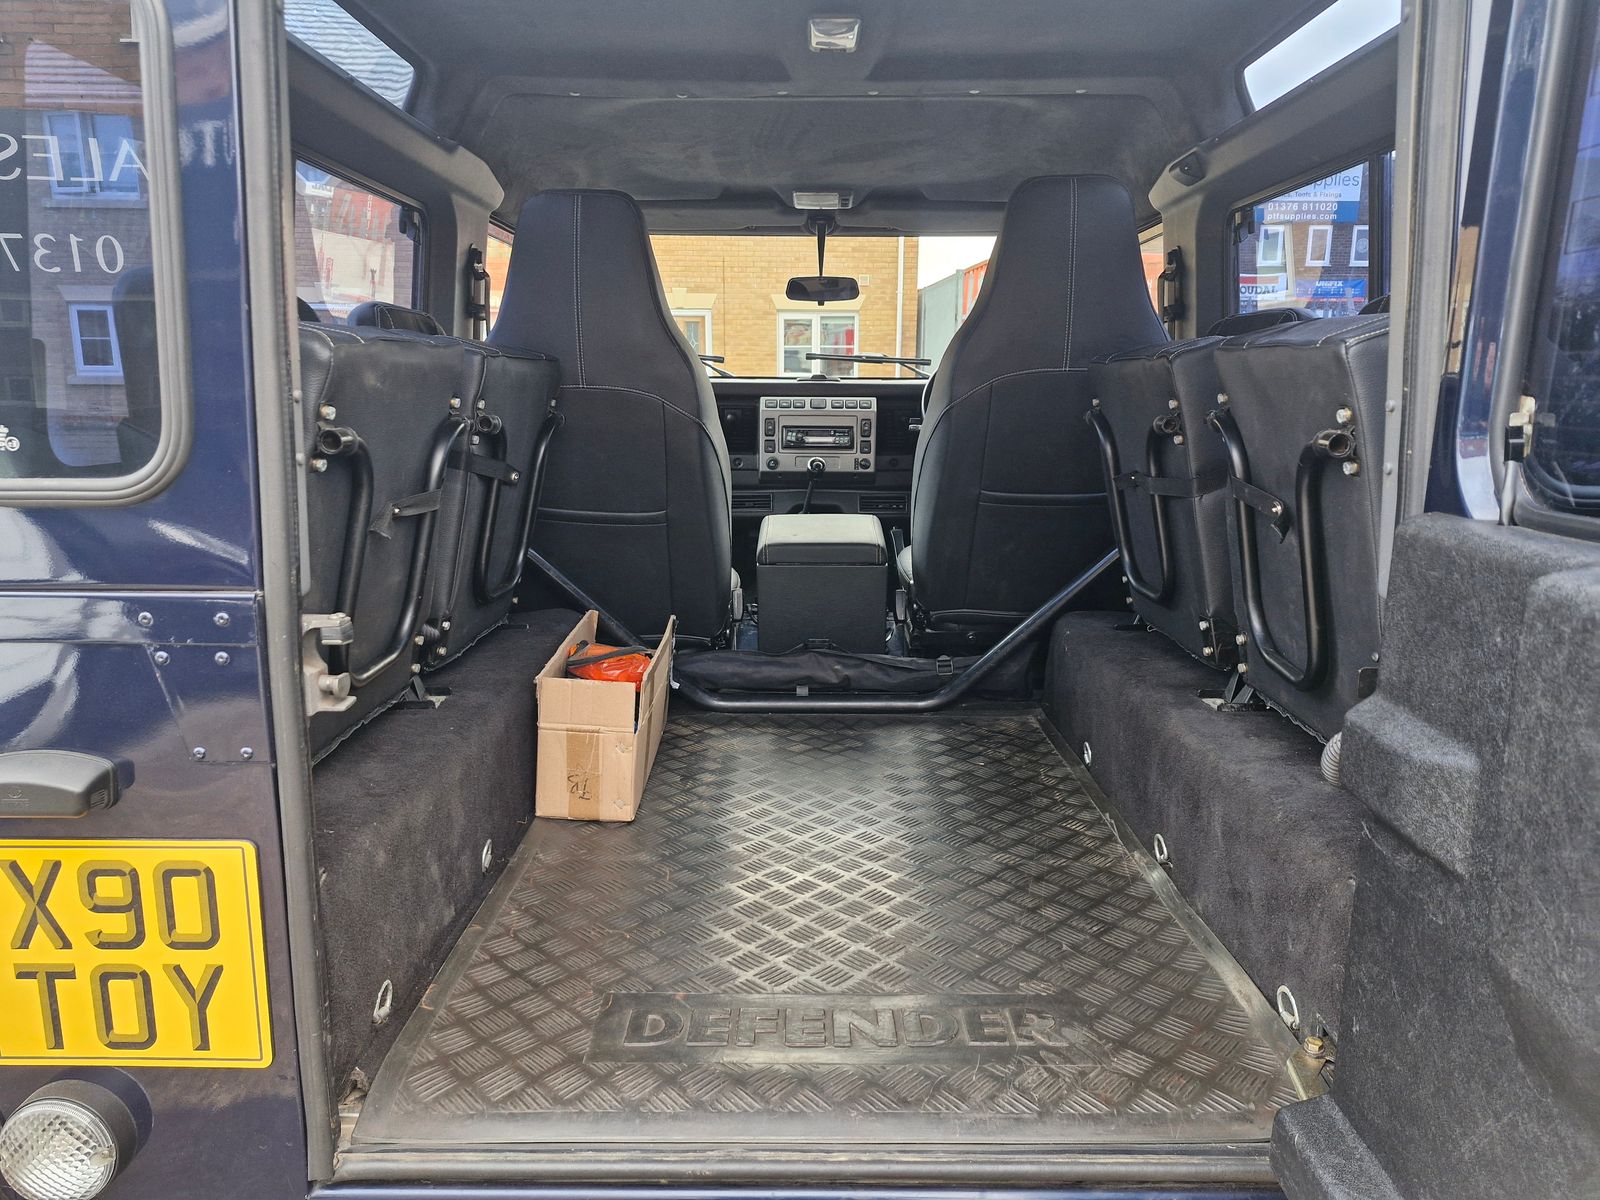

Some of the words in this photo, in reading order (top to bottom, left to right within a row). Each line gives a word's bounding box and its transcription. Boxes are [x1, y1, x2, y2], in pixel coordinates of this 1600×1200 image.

[1267, 202, 1299, 211] 01376
[1302, 202, 1338, 211] 811020
[1267, 212, 1338, 221] ptfsupplies.com
[0, 859, 221, 950] X90
[13, 962, 224, 1052] TOY
[623, 1007, 1069, 1048] DEFENDER
